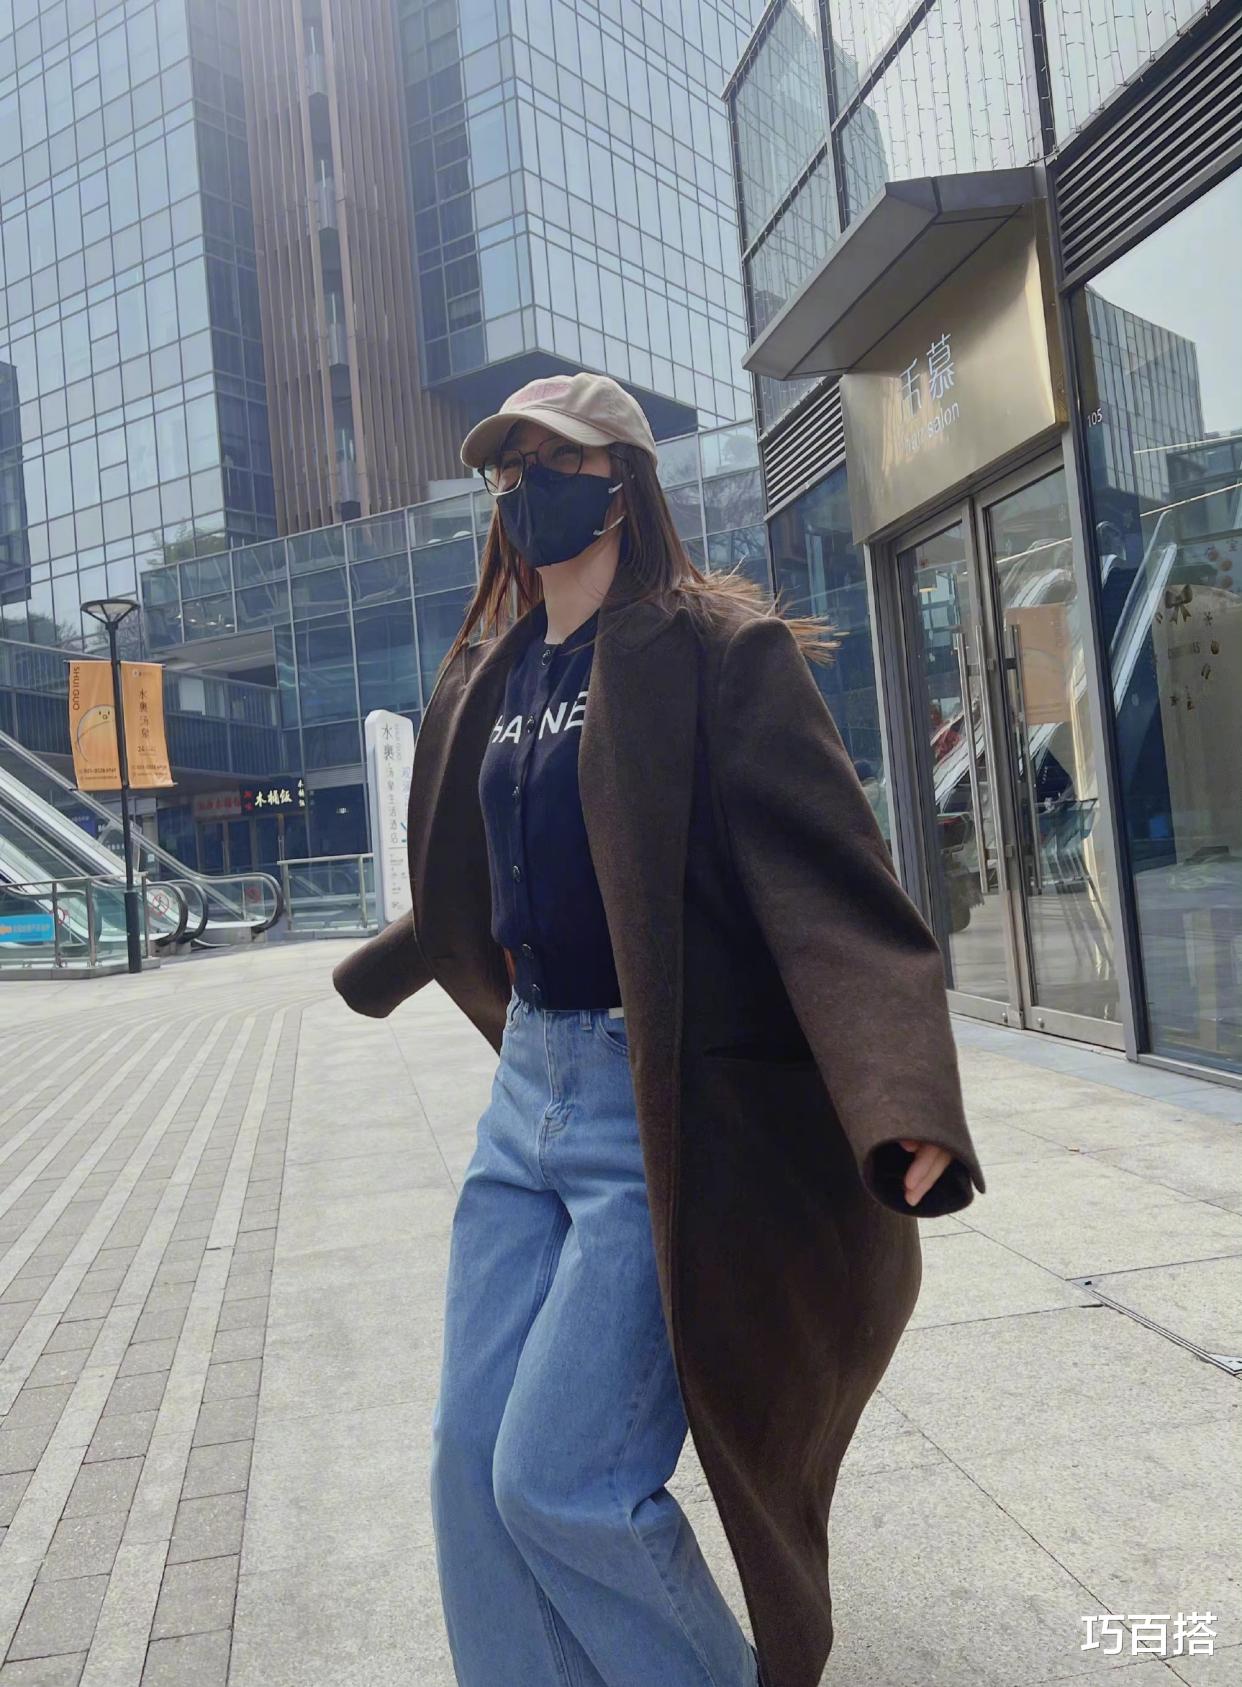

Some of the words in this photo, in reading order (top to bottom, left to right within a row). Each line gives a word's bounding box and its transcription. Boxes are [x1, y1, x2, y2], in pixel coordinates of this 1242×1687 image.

[926, 402, 960, 438] salon
[1087, 407, 1103, 428] 105
[72, 689, 80, 711] GUO
[254, 788, 293, 808] 木桶饭
